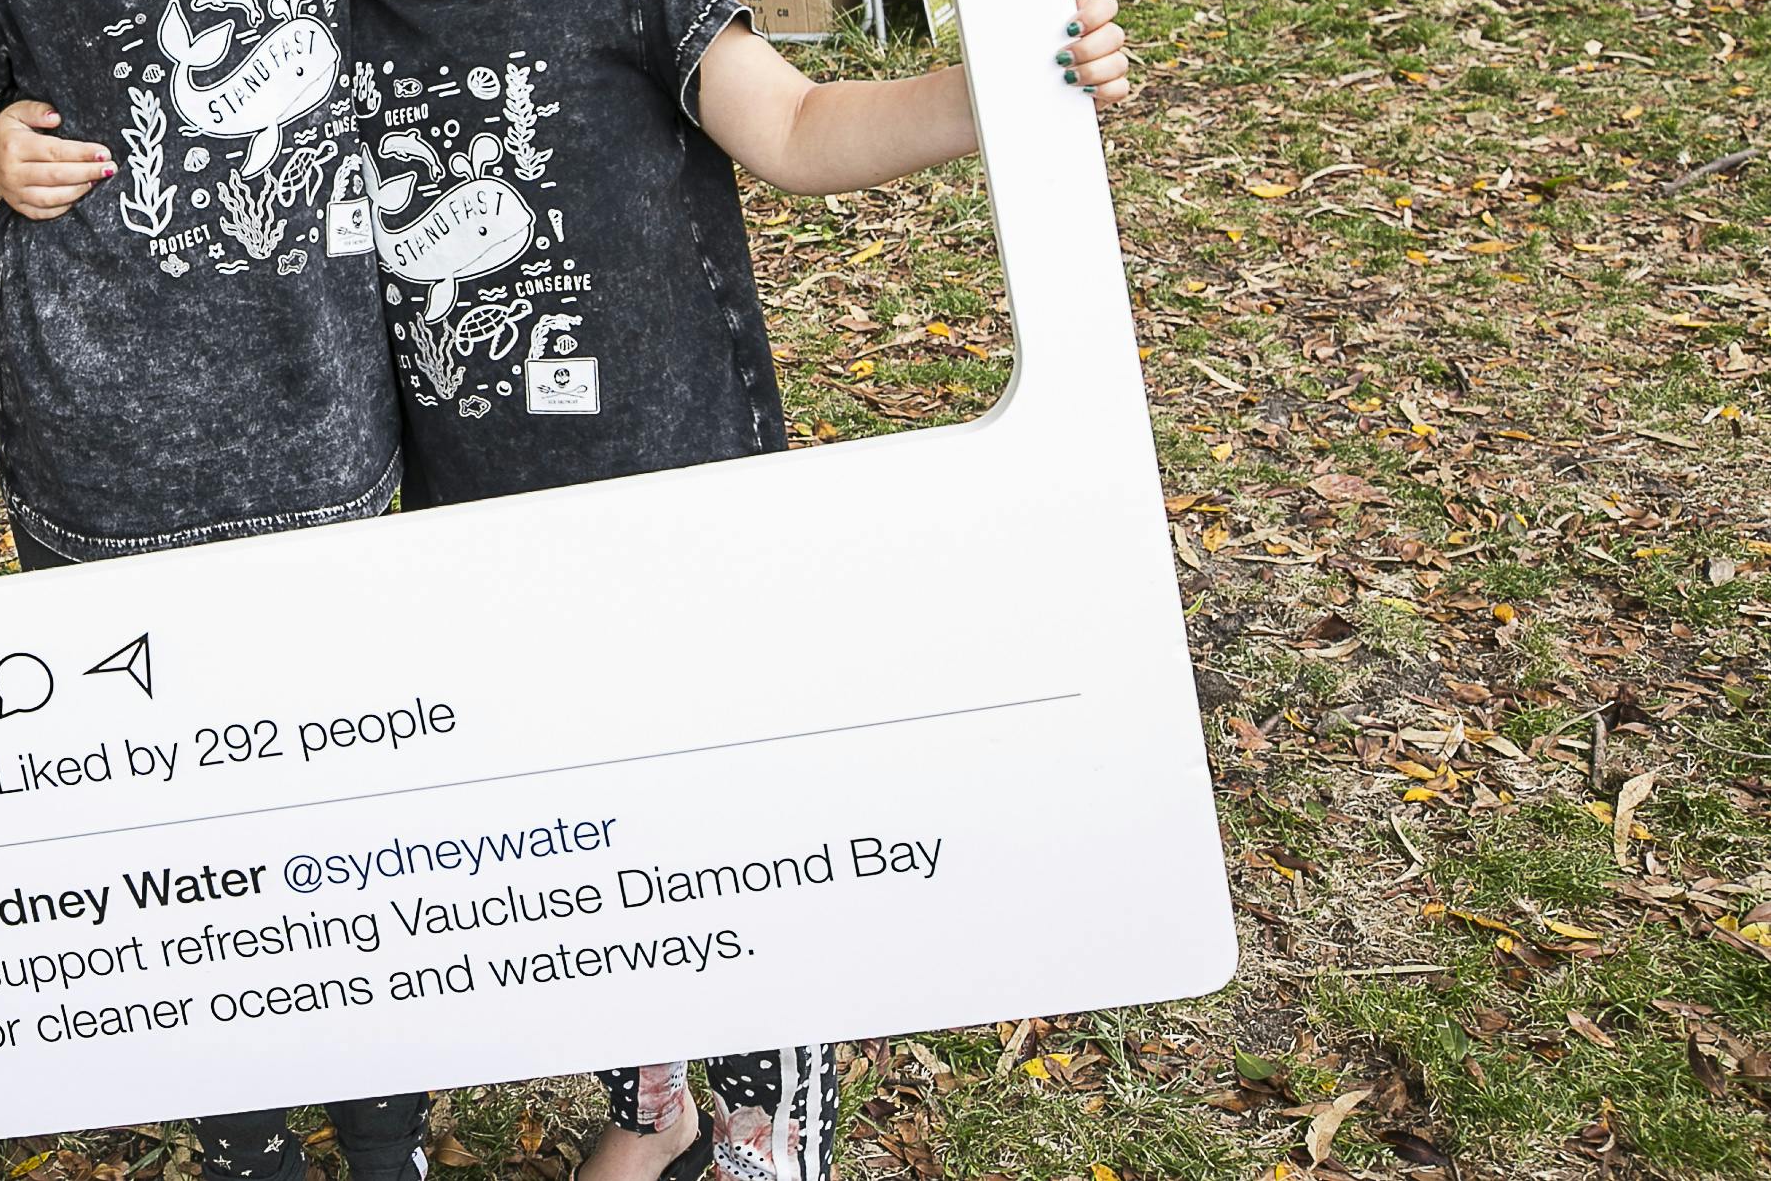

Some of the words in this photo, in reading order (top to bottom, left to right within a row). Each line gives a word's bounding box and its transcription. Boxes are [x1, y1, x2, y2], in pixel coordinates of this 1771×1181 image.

[208, 58, 271, 124] STAND
[268, 30, 316, 68] FAST
[384, 102, 429, 127] DEFEND
[149, 223, 211, 257] PROTECT
[394, 212, 450, 267] STAND
[448, 190, 504, 225] FAST
[514, 273, 592, 298] CONSERVE
[124, 738, 178, 782] by
[195, 719, 284, 767] 292
[298, 697, 456, 762] people
[122, 865, 267, 909] Water
[283, 817, 617, 895] @sydneywater
[161, 913, 381, 967] refreshing
[390, 884, 603, 937] Vaucluse
[617, 843, 834, 909] Diamond
[849, 837, 942, 879] Bay
[37, 997, 194, 1043] cleaner
[210, 976, 374, 1022] oceans
[389, 953, 475, 1001] and
[487, 929, 755, 988] waterways.
